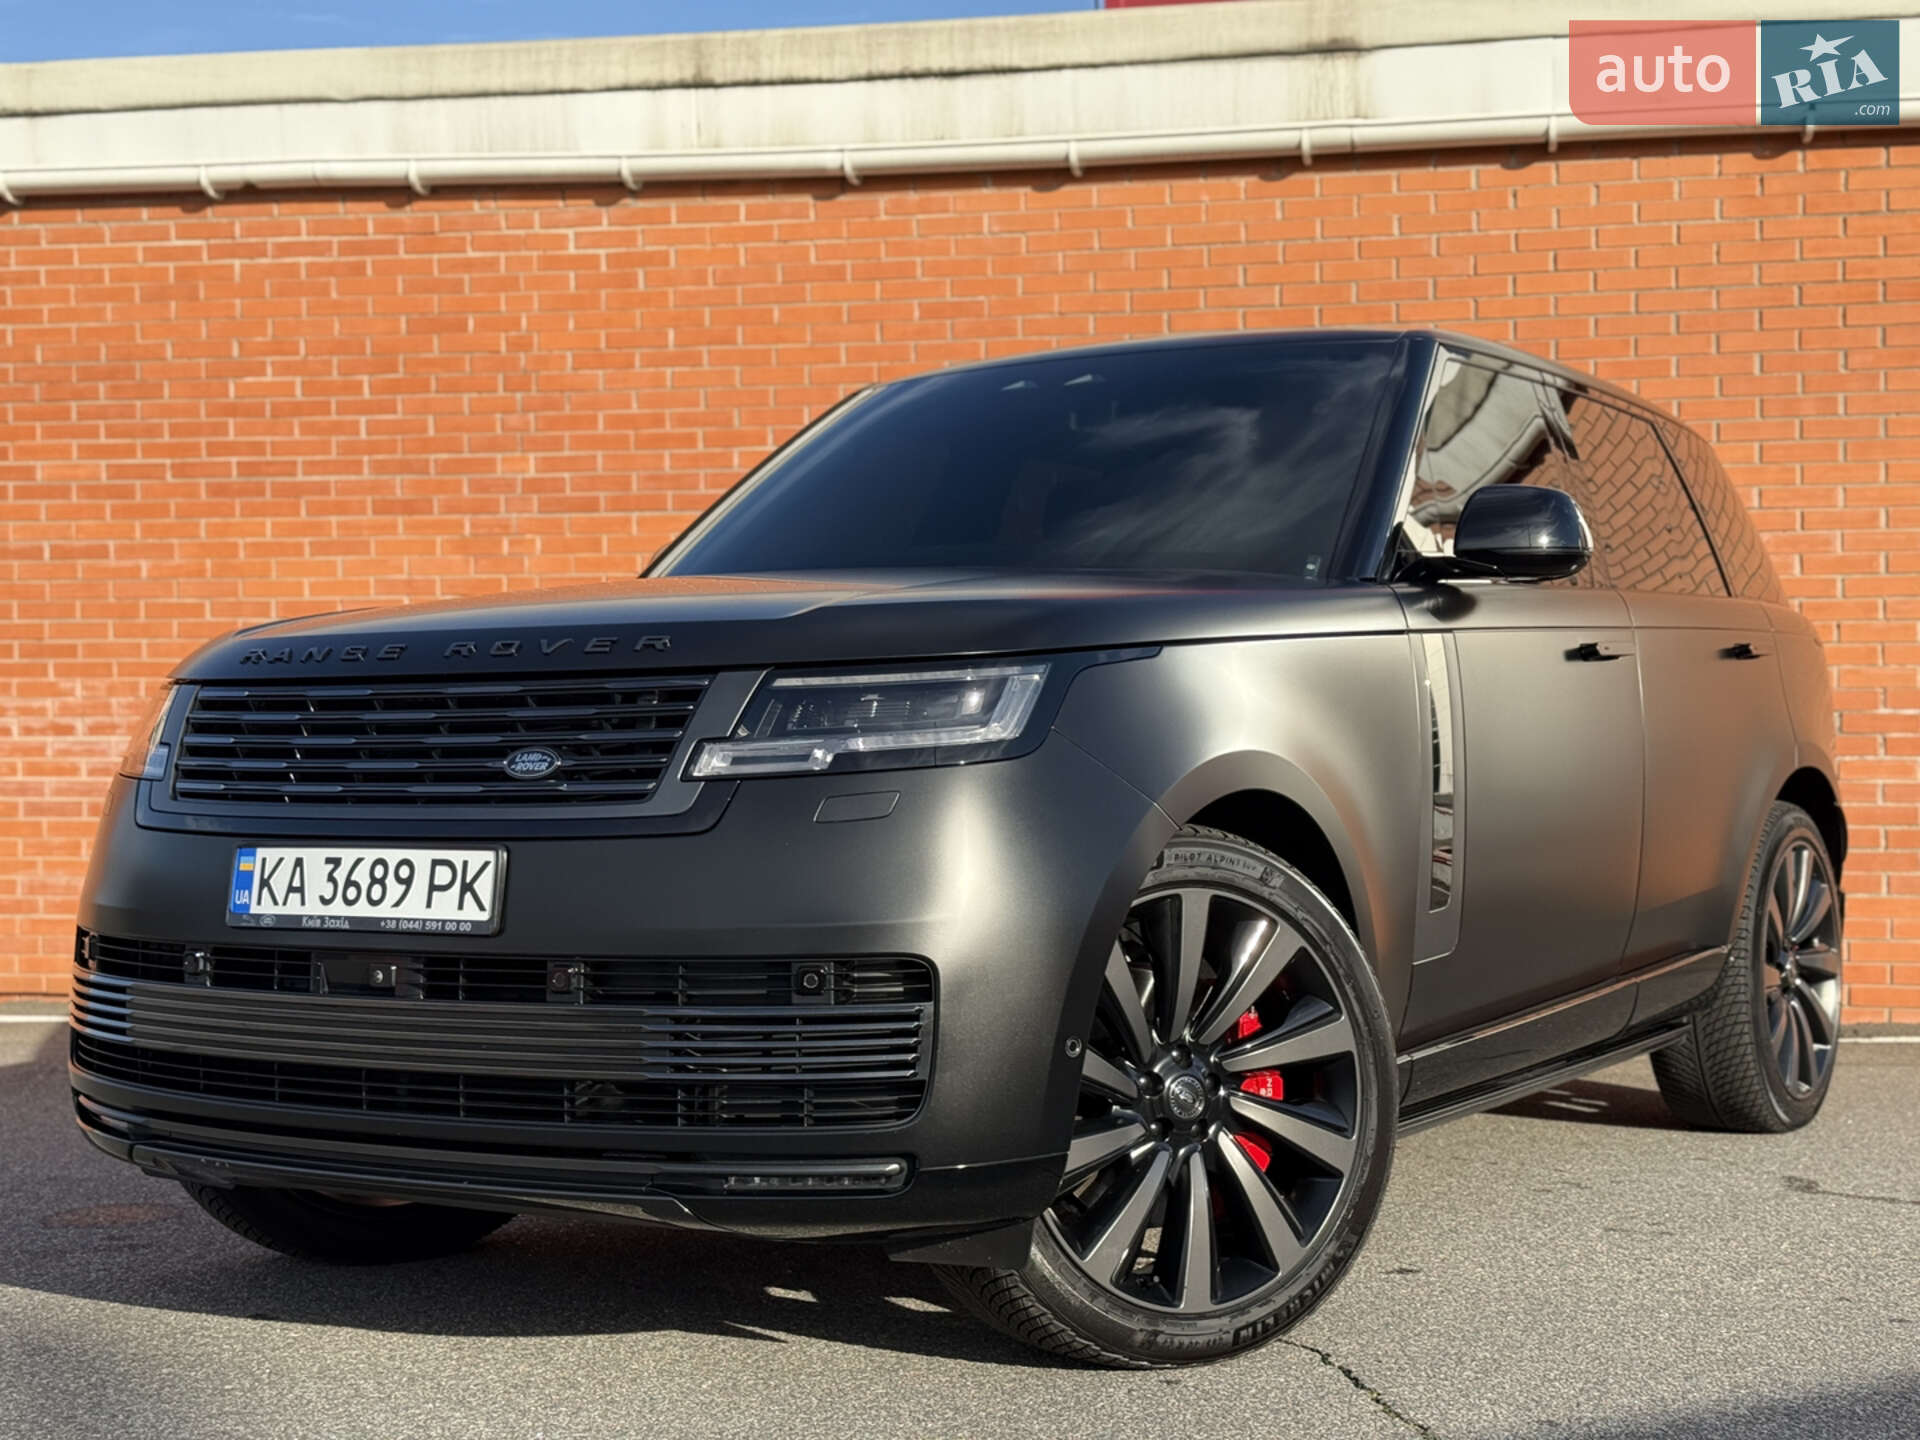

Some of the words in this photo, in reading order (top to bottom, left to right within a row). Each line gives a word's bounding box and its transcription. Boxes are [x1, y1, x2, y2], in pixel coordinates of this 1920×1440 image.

[239, 643, 408, 664] RANGE
[443, 634, 674, 658] ROVER
[514, 753, 543, 762] LAND
[514, 762, 549, 771] ROVER
[256, 857, 306, 906] KA
[319, 857, 416, 909] 3689
[425, 858, 493, 912] PK
[234, 889, 251, 905] UA
[380, 919, 397, 929] +38
[398, 919, 424, 930] (044)
[425, 921, 442, 931] 591
